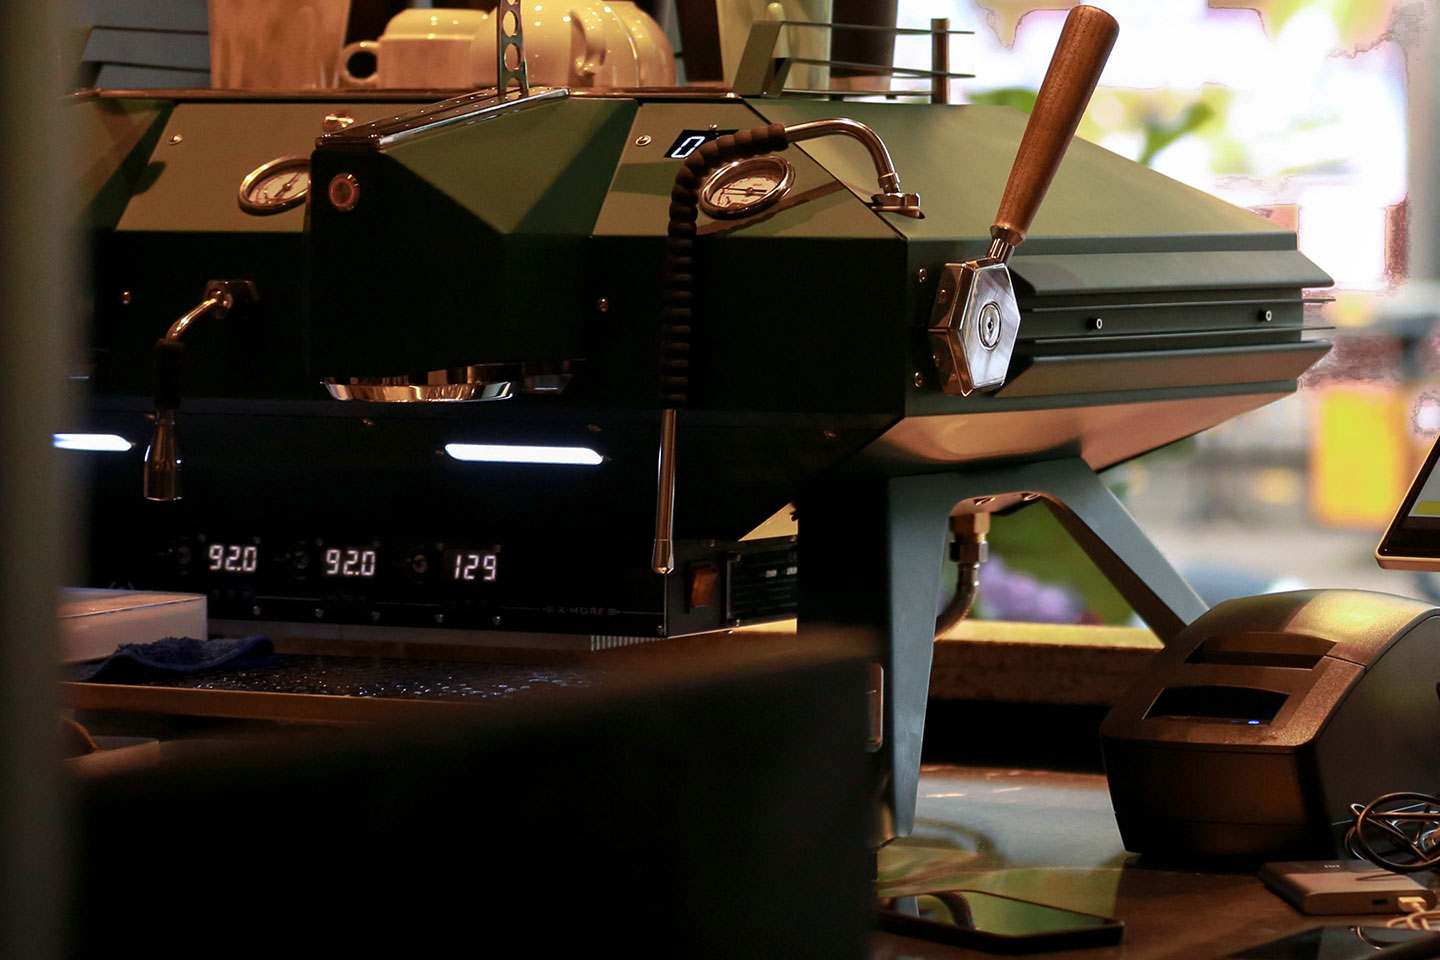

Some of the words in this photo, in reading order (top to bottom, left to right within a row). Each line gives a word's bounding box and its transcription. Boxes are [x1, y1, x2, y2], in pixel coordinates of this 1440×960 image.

[208, 544, 258, 573] 92.0
[325, 548, 377, 577] 92.0
[453, 554, 498, 582] 129
